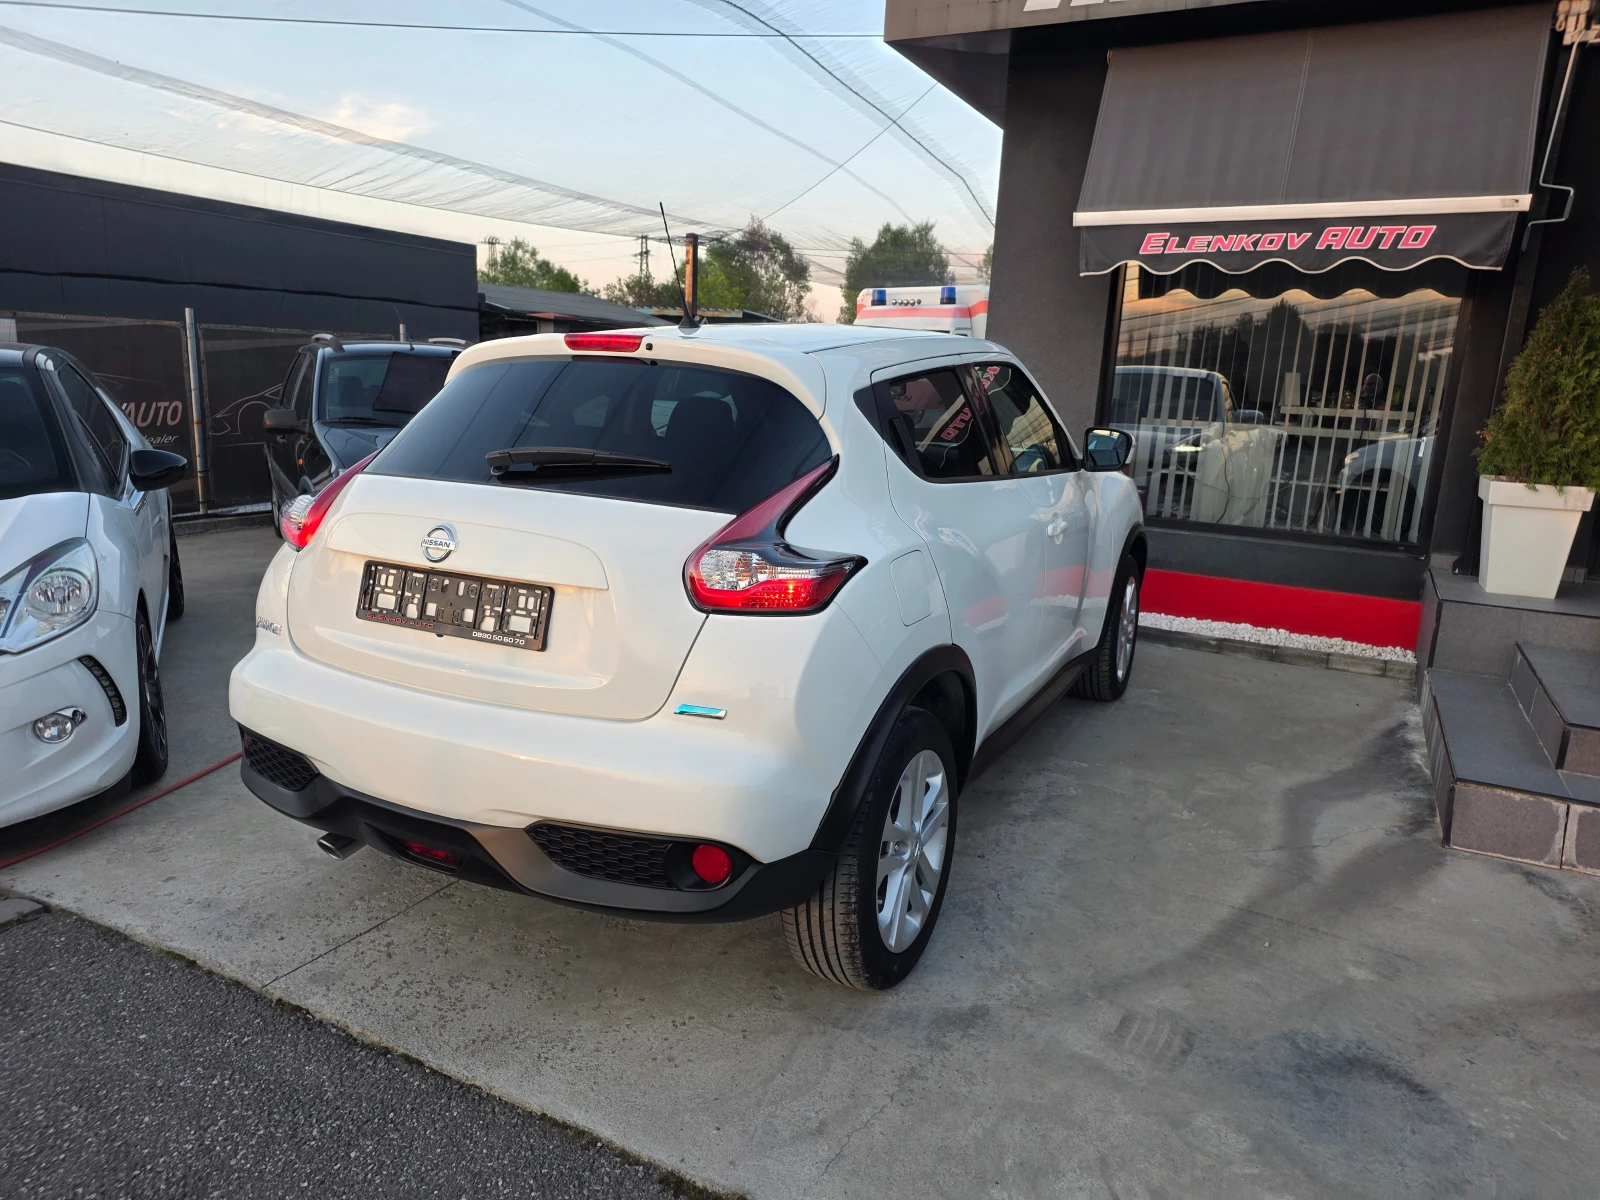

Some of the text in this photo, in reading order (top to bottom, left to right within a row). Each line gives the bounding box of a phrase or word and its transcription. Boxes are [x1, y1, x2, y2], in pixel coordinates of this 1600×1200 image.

[1139, 225, 1437, 254] ELENKOV AUTO
[422, 538, 451, 549] NISSAN
[409, 620, 435, 629] AUTO
[492, 634, 503, 642] 50
